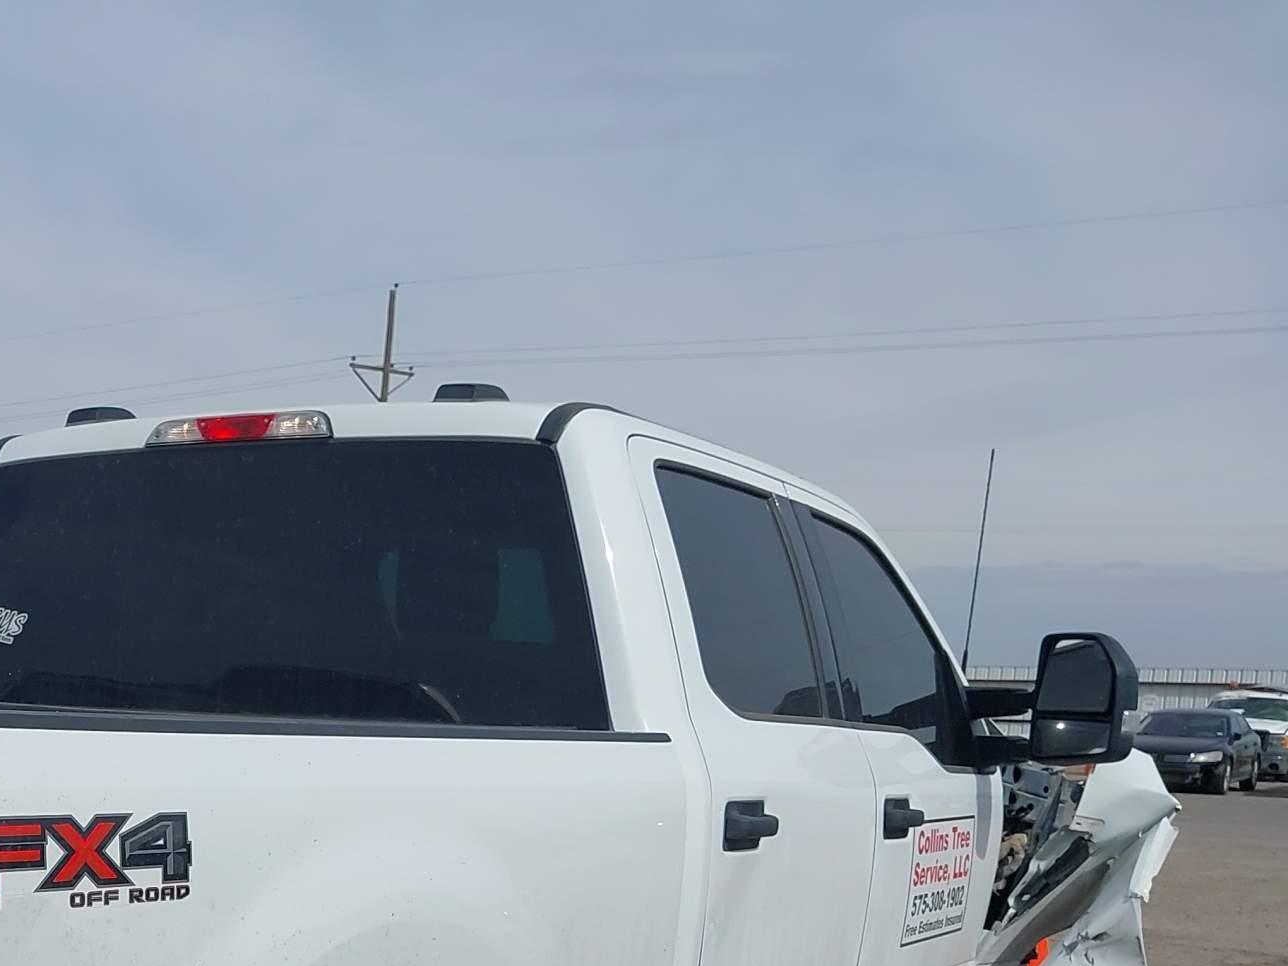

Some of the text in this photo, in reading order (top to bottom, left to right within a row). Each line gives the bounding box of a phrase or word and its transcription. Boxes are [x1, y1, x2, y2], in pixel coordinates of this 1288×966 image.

[917, 826, 971, 856] Collins Tree
[913, 854, 970, 887] Service, LLC
[69, 884, 191, 908] OFF ROAD
[911, 885, 965, 917] 575-308-1902
[904, 923, 918, 938] Free
